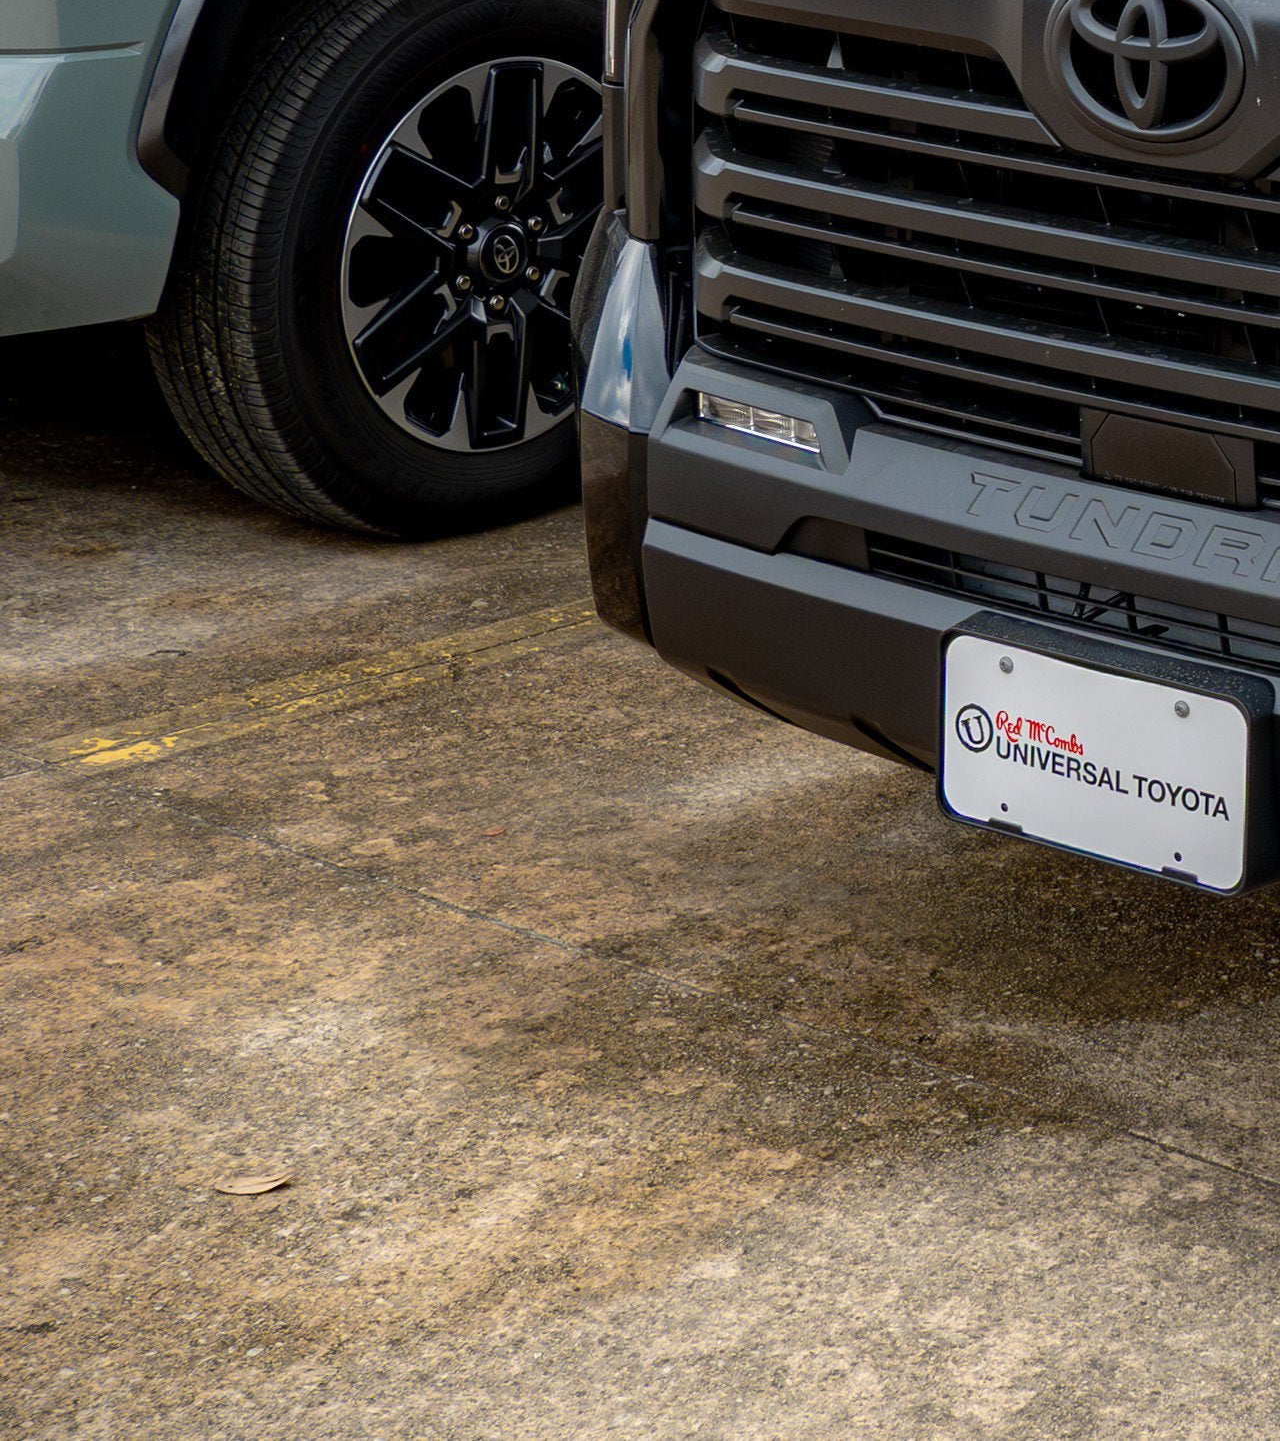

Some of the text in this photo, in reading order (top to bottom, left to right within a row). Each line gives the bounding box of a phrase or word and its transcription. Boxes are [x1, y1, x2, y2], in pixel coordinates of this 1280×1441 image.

[995, 710, 1084, 756] Red McCombs
[996, 735, 1231, 822] UNIVERSAL TOYOTA
